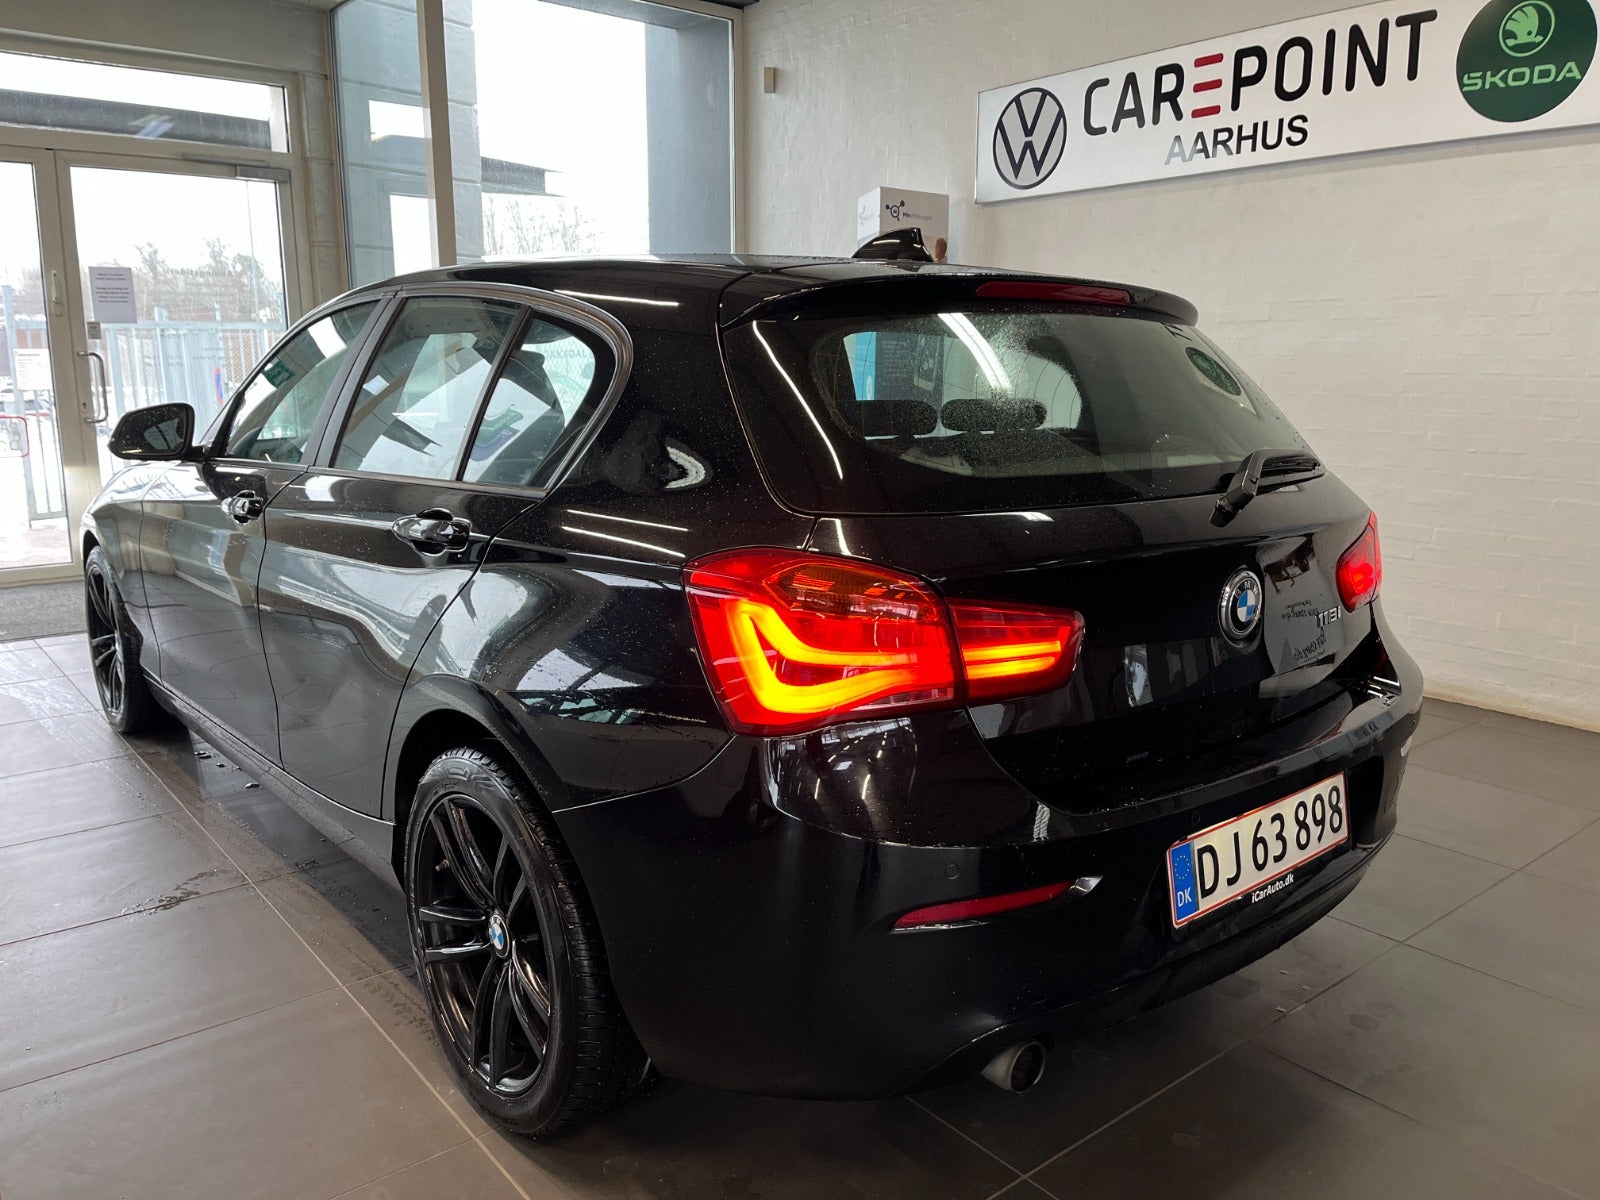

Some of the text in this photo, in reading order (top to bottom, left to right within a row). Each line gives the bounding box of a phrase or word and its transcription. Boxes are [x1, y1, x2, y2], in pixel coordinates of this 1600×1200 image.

[1083, 9, 1438, 136] CAREPOINT
[1164, 114, 1309, 166] AARHUS
[1197, 785, 1343, 899] DJ 63 898
[1177, 887, 1192, 907] DK
[1251, 873, 1294, 904] iCarAuto.dk
